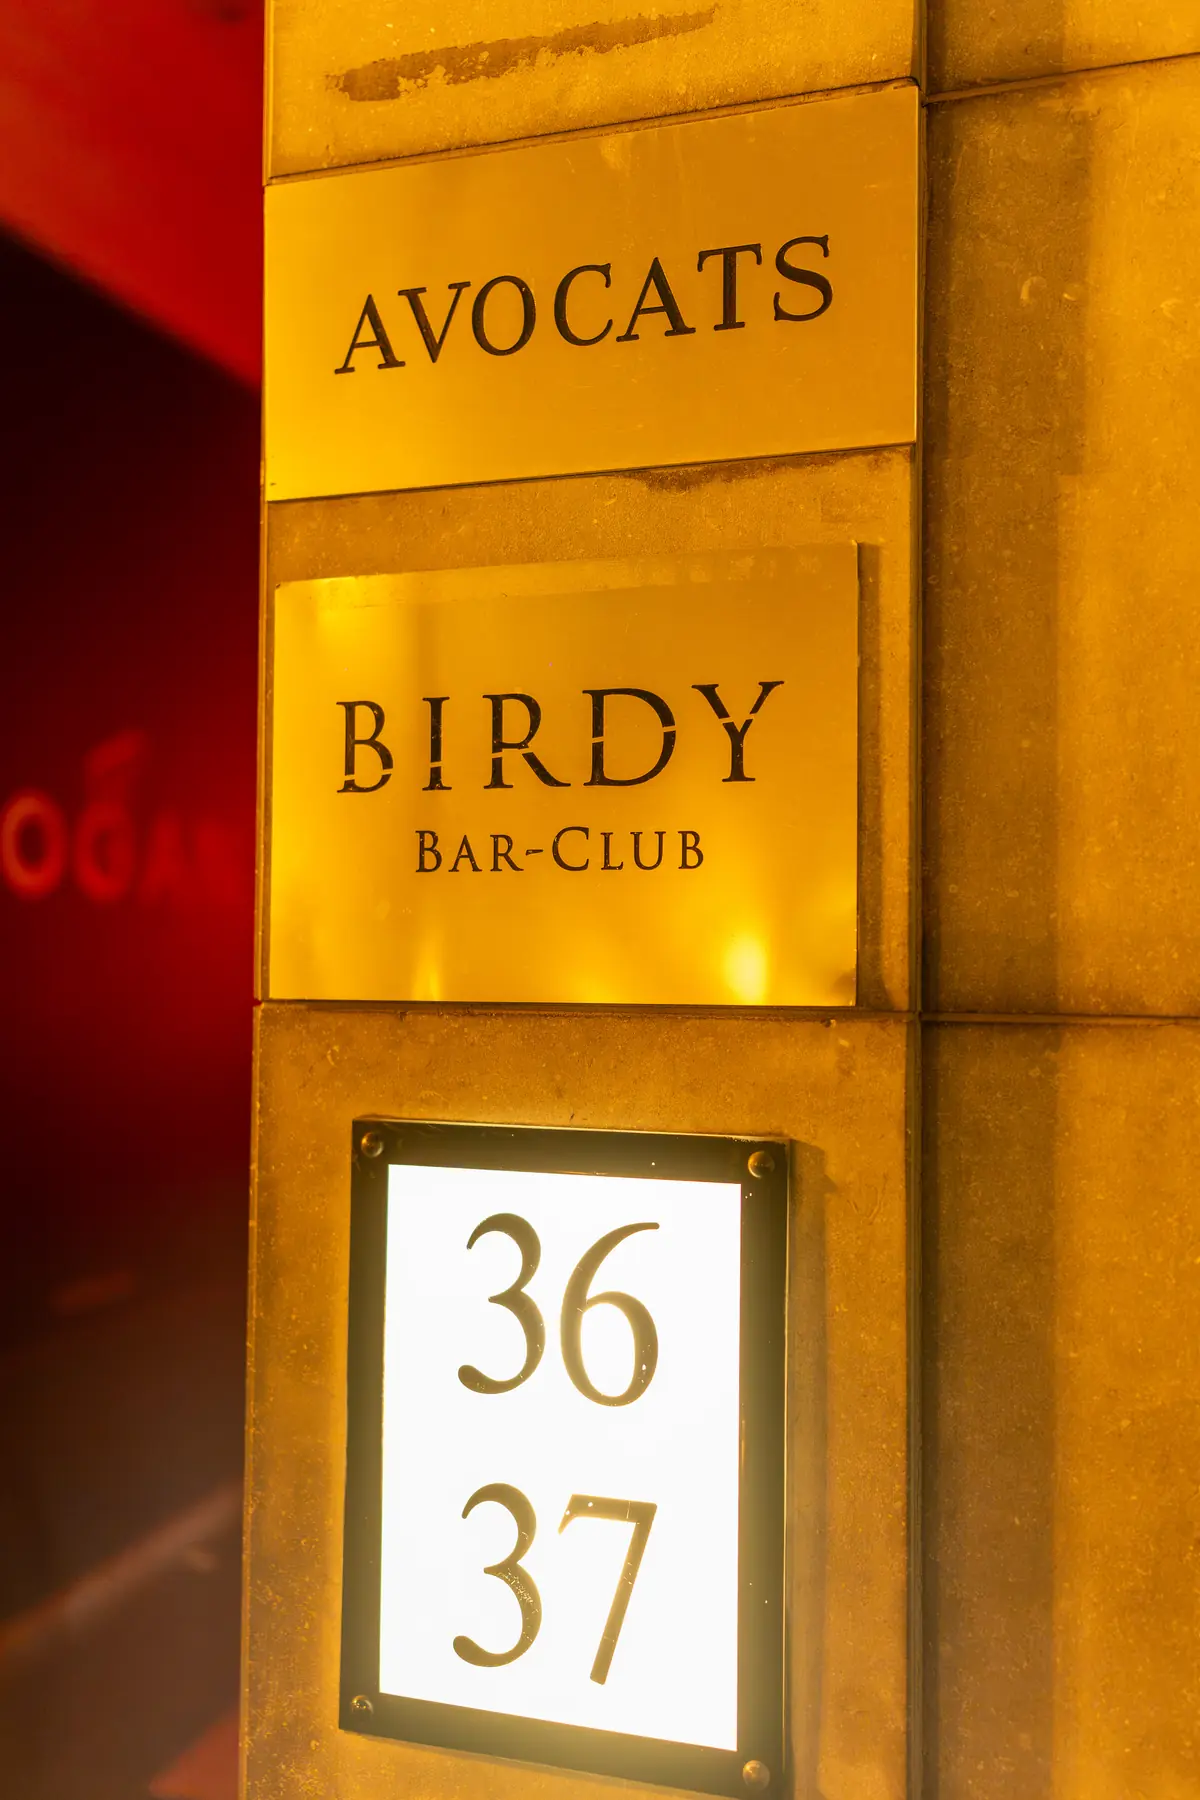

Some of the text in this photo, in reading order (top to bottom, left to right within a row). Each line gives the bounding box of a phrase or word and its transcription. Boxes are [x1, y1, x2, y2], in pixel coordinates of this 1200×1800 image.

[333, 234, 833, 375] AVOCATS
[335, 680, 785, 793] BIRDY
[415, 826, 704, 873] BAR-CLUB
[457, 1212, 660, 1407] 36
[452, 1482, 658, 1686] 37
